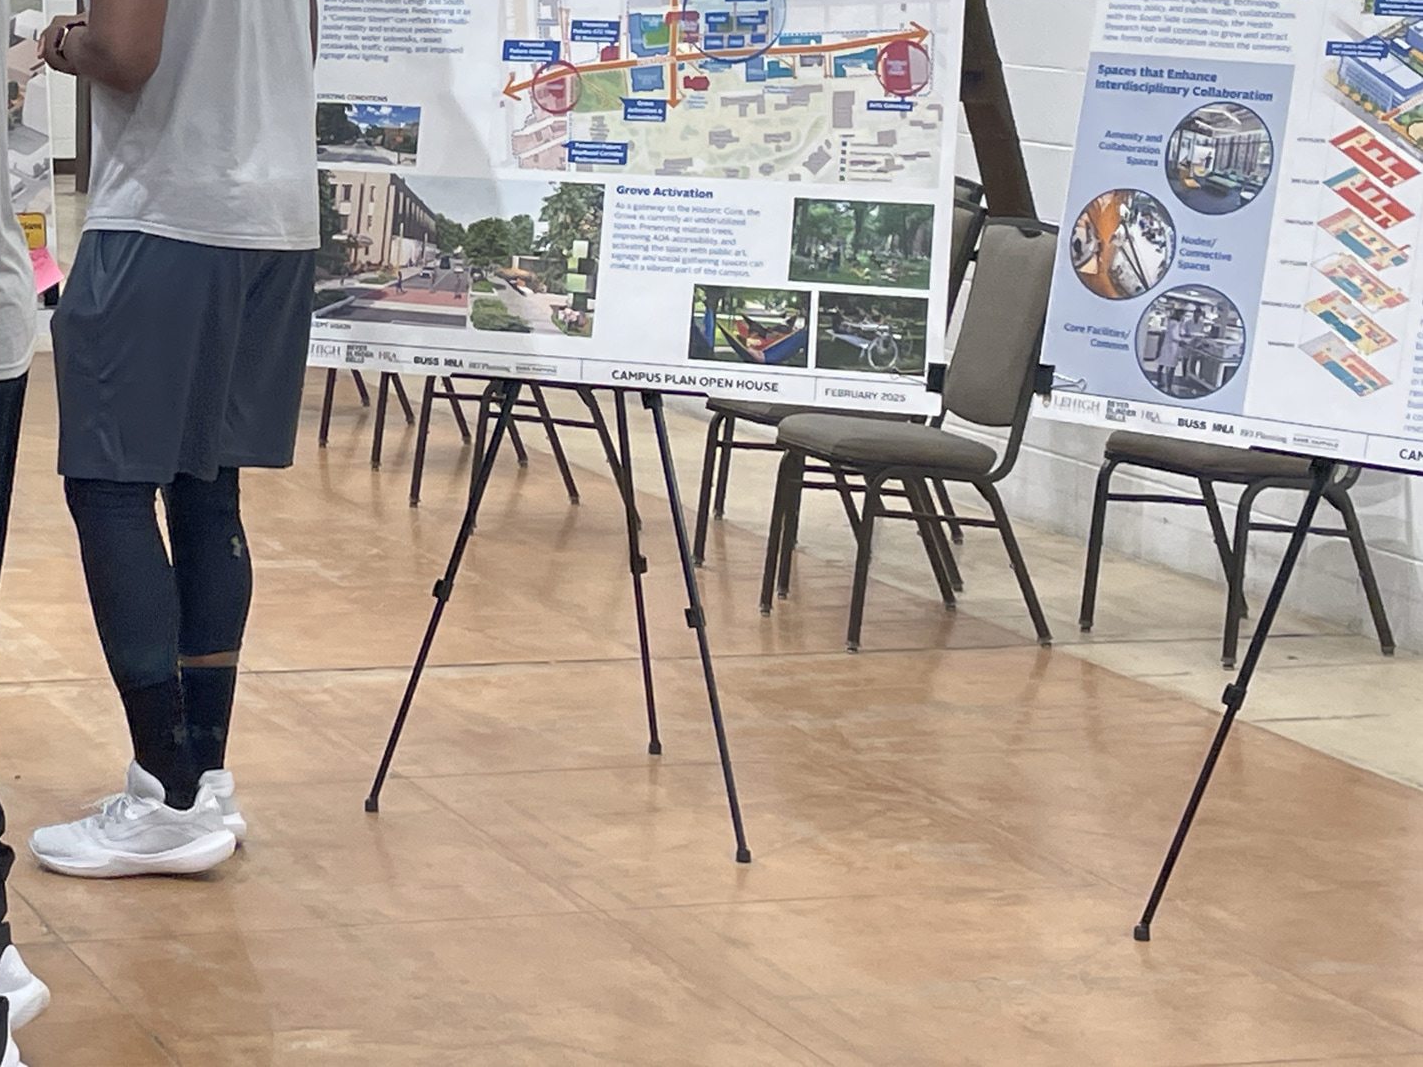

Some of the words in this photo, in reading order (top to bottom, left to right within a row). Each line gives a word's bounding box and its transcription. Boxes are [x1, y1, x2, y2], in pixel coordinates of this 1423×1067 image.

[1098, 64, 1137, 77] Spaces
[1140, 66, 1164, 78] that
[1167, 68, 1217, 82] Enhance
[1095, 79, 1190, 98] Interdisciplinary
[1192, 86, 1273, 102] Collaboration
[1105, 130, 1143, 143] Amenity
[1145, 133, 1163, 143] and
[1098, 142, 1161, 155] Collaboration
[1126, 156, 1159, 167] Spaces
[616, 185, 650, 196] Grove
[653, 187, 713, 199] Activation
[1181, 236, 1217, 249] Nodes/
[1179, 247, 1232, 261] Connective
[1177, 260, 1211, 272] Spaces
[1064, 323, 1085, 333] Core
[1087, 324, 1131, 340] Facilities/
[1090, 338, 1129, 351] Common
[413, 355, 439, 367] BUSS
[611, 369, 662, 383] CAMPUS
[664, 373, 696, 386] PLAN
[699, 376, 733, 389] OPEN
[736, 379, 779, 392] HOUSE
[825, 388, 877, 400] FEBRUARY
[880, 391, 906, 402] 2025
[1053, 396, 1101, 412] LEHIGH
[1177, 418, 1207, 430] BUSS
